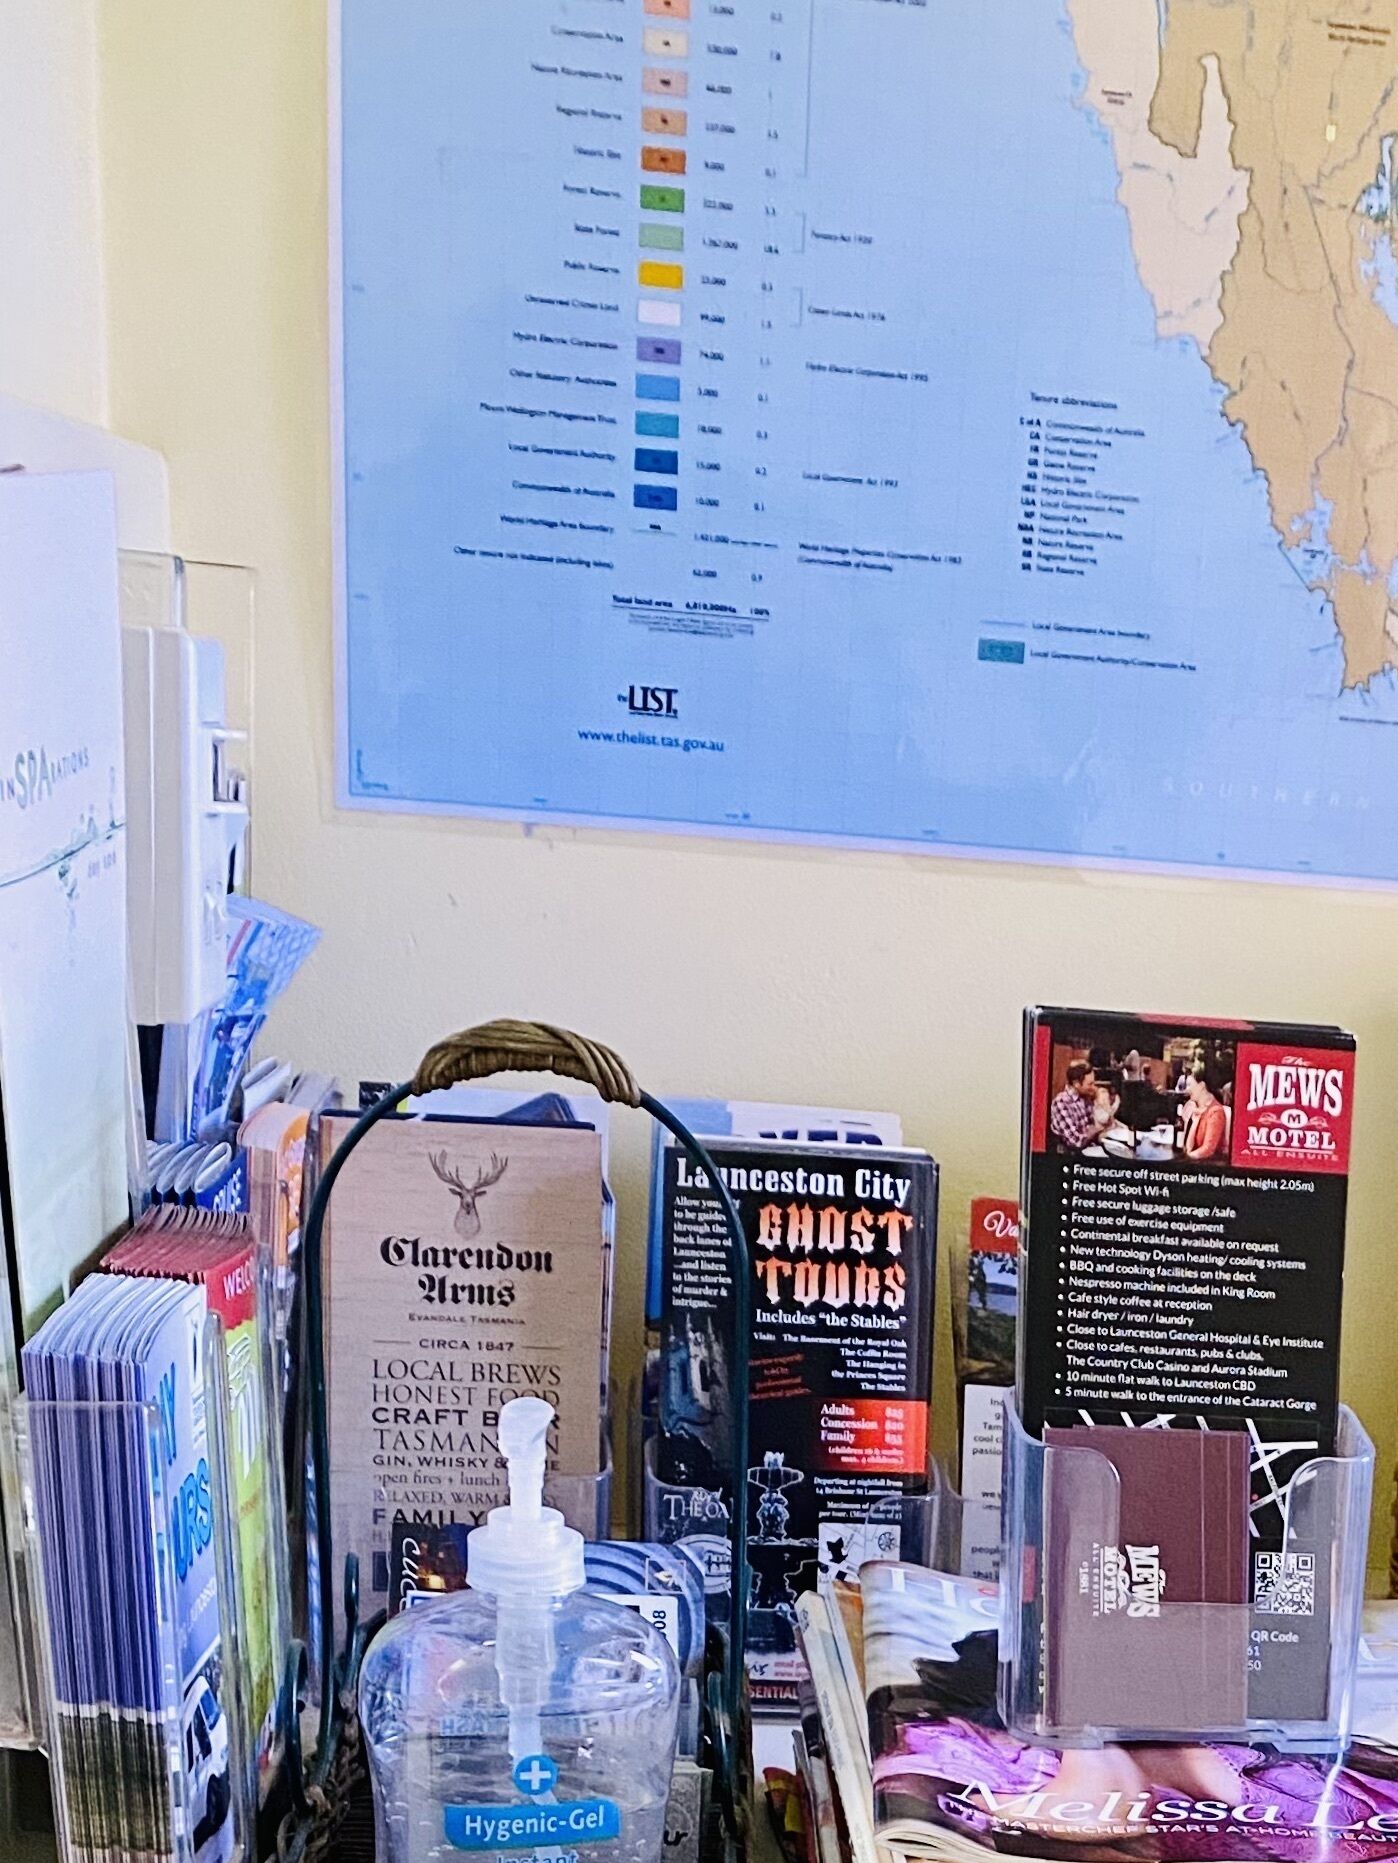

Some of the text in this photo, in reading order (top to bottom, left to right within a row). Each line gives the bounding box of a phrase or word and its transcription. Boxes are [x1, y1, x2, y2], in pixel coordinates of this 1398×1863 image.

[628, 684, 679, 715] LIST
[578, 729, 724, 752] www.thelist.tas.gov.au
[1247, 1063, 1344, 1118] MEWS
[1247, 1126, 1336, 1150] MOTEL
[676, 1157, 911, 1208] Launceston City
[1073, 1180, 1095, 1193] Free
[1098, 1183, 1117, 1195] Hot
[1119, 1184, 1142, 1197] Spot
[1074, 1164, 1097, 1176] Free
[1098, 1168, 1132, 1179] secure
[1134, 1168, 1148, 1180] off
[1150, 1171, 1179, 1182] street
[1182, 1173, 1220, 1187] parking
[1247, 1176, 1278, 1190] height
[756, 1201, 914, 1257] GHOST
[1071, 1229, 1279, 1254] Continental breakfast available on request
[380, 1235, 553, 1273] Clarendon
[418, 1273, 516, 1308] Arms
[755, 1255, 906, 1311] TOURS
[756, 1309, 816, 1325] Includes
[418, 1338, 514, 1352] CIRCA 1847
[373, 1358, 561, 1386] LOCAL BREWS
[373, 1383, 477, 1407] HONEST
[1065, 1386, 1317, 1412] 5 minute walk to the entrance of the Cataract Gorge
[372, 1407, 469, 1426] CRAFT
[821, 1404, 855, 1416] Adults
[821, 1417, 878, 1430] Concession
[821, 1430, 855, 1443] Family
[373, 1454, 412, 1467] GIN,
[418, 1456, 493, 1469] WHISKY
[413, 1468, 500, 1487] fires lunch
[373, 1508, 485, 1527] FAMILY
[1126, 1544, 1161, 1618] MEWS
[1251, 1630, 1299, 1644] QR Code
[947, 1780, 1283, 1825] Melissa
[465, 1804, 605, 1842] Hygenic-Gel
[992, 1815, 1146, 1835] MASTERCHEF
[1146, 1822, 1218, 1834] STAR'S
